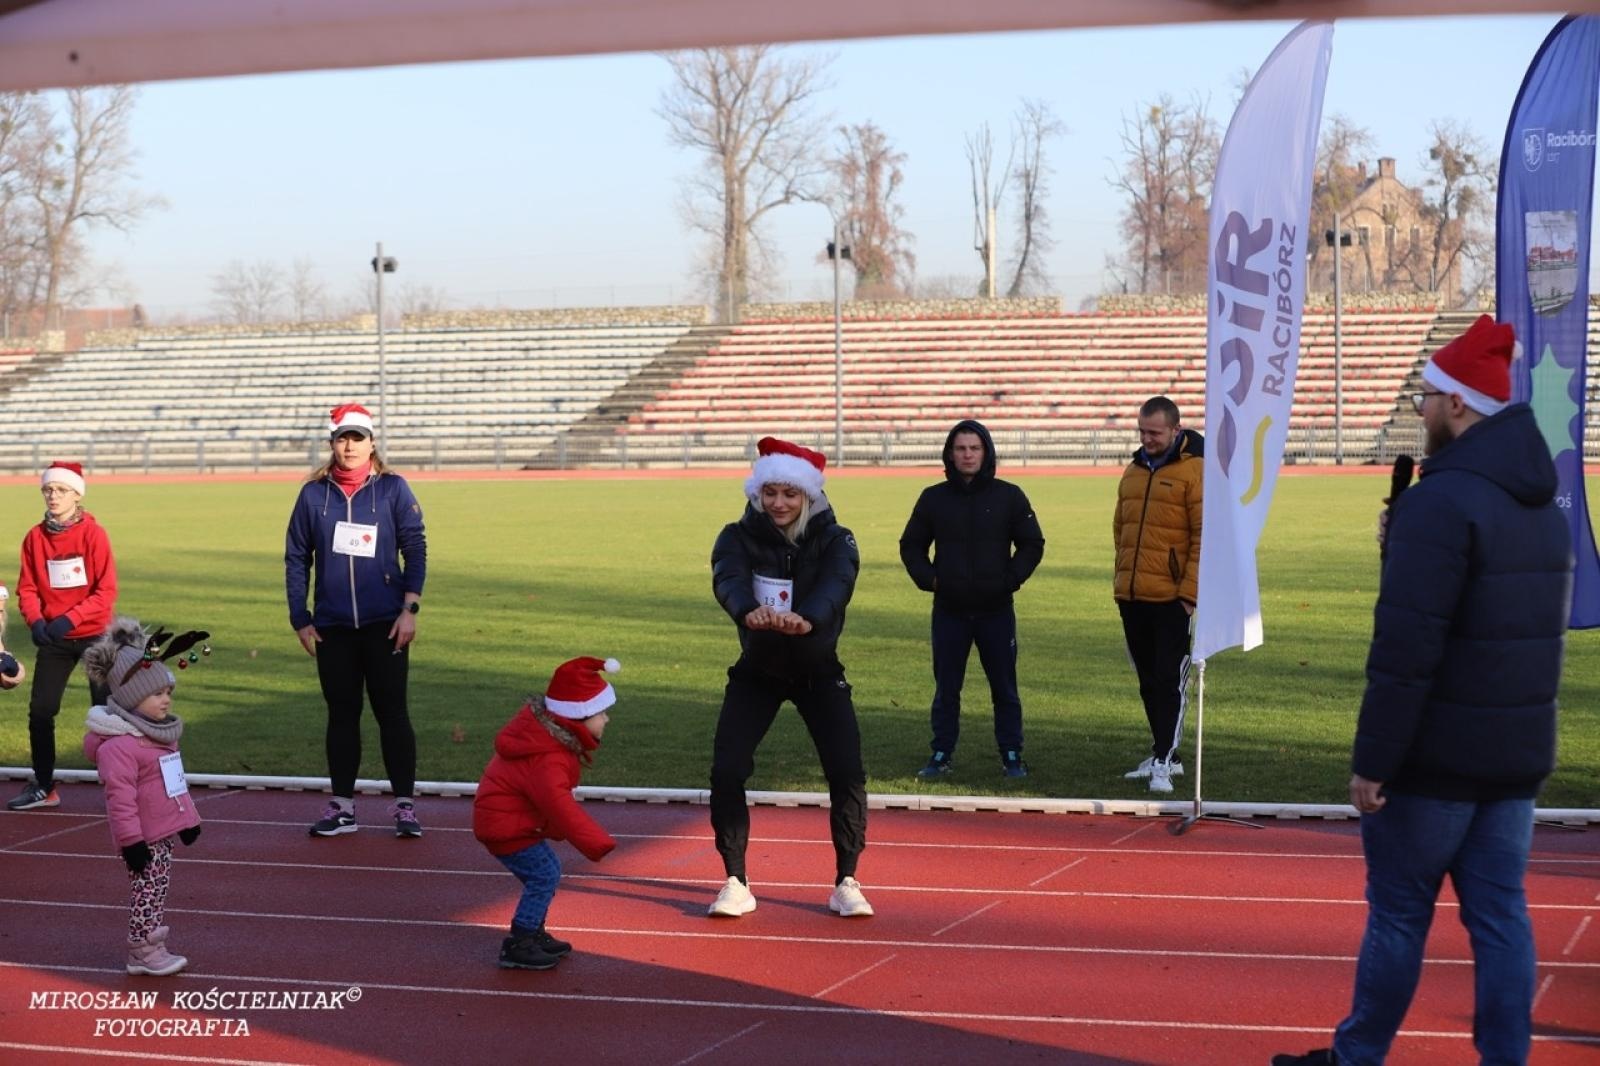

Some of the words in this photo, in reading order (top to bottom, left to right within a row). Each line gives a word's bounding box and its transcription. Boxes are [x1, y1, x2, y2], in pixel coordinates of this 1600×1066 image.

[1261, 221, 1296, 397] RACIBÓRZ
[1553, 492, 1572, 509] oś
[765, 597, 775, 607] 13
